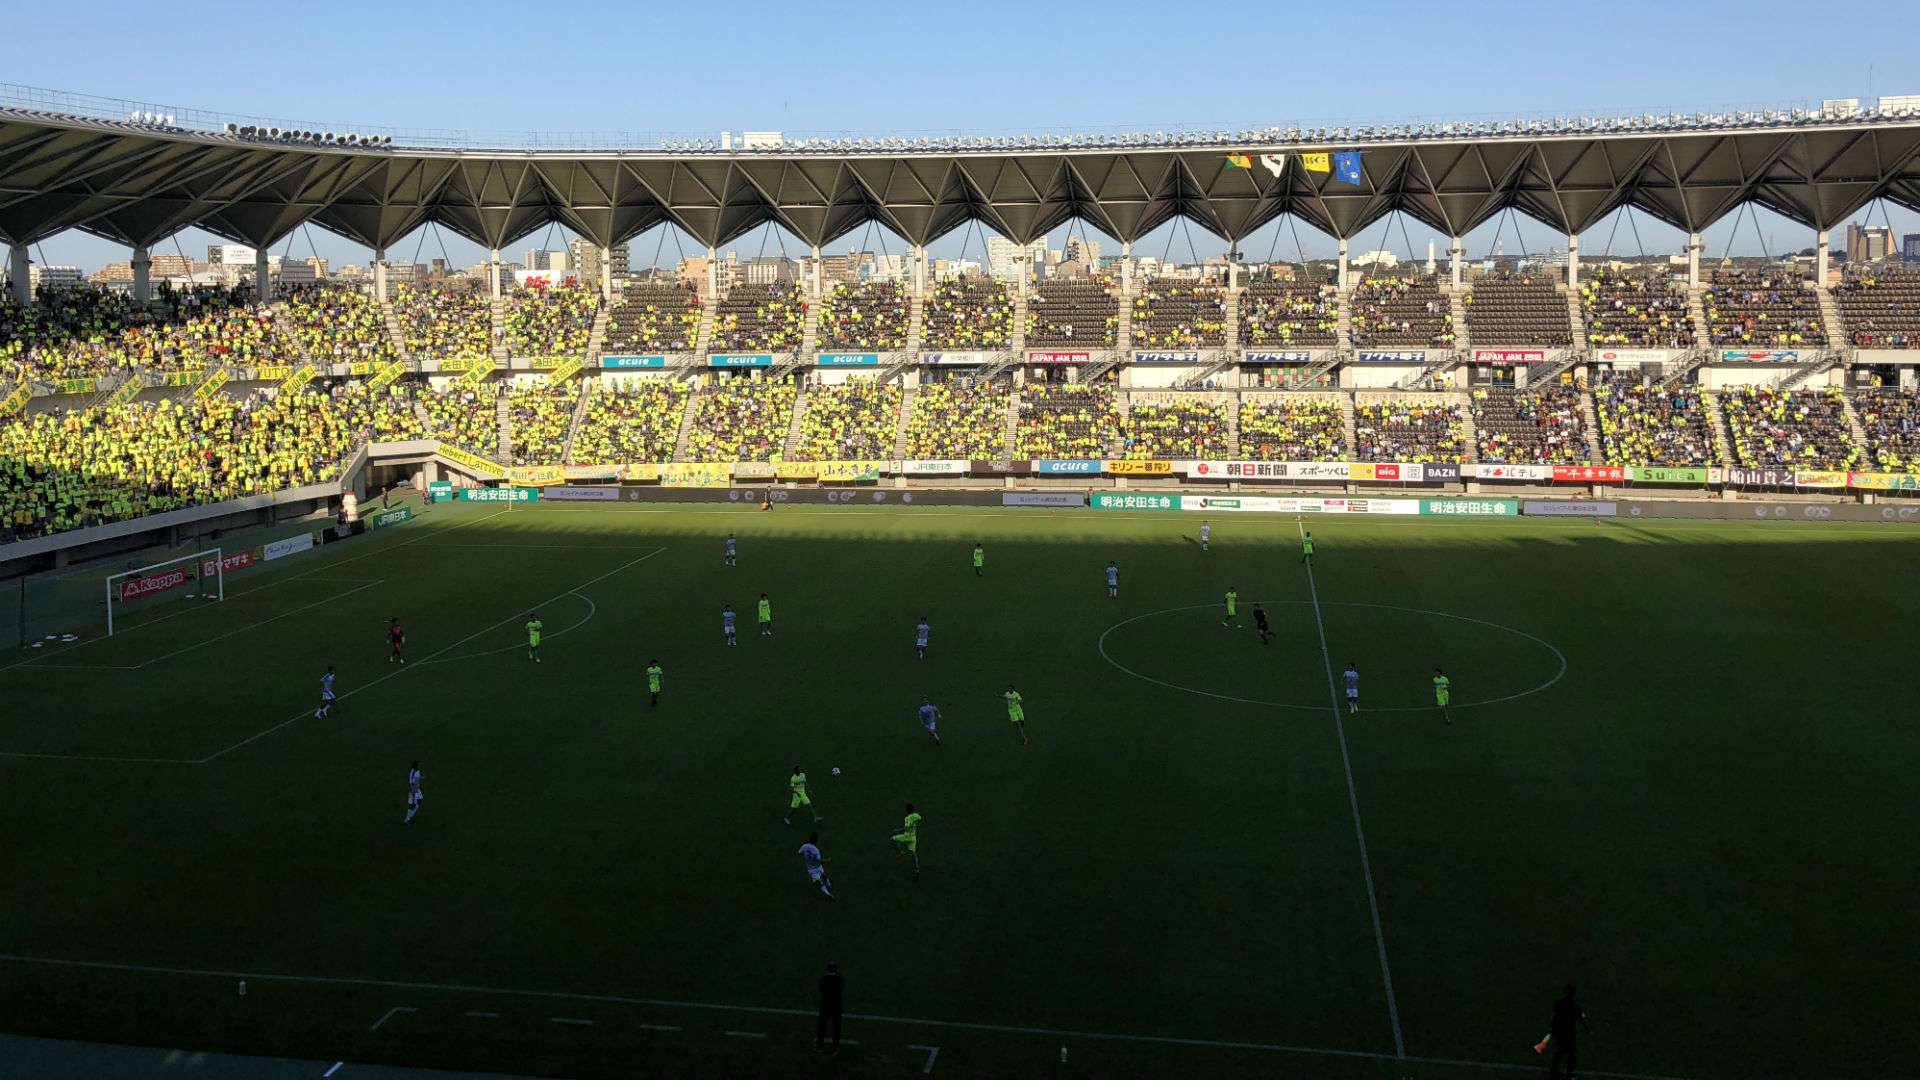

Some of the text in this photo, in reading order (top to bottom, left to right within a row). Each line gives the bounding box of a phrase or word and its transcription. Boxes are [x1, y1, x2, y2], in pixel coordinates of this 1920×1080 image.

[618, 357, 649, 366] acure
[727, 356, 757, 364] acure
[833, 355, 863, 363] acure
[1052, 462, 1089, 472] acure
[1109, 462, 1171, 473] キリン一番搾り
[1226, 463, 1288, 476] 朝日新聞
[1300, 466, 1349, 477] スポーツくじ
[1428, 468, 1456, 478] DAZN
[1644, 469, 1696, 481] Suica
[468, 489, 528, 501] 明治安田生命
[1100, 496, 1171, 509] 明治安田生命
[1430, 501, 1506, 514] 明治安田生命
[137, 571, 184, 592] Kappa
